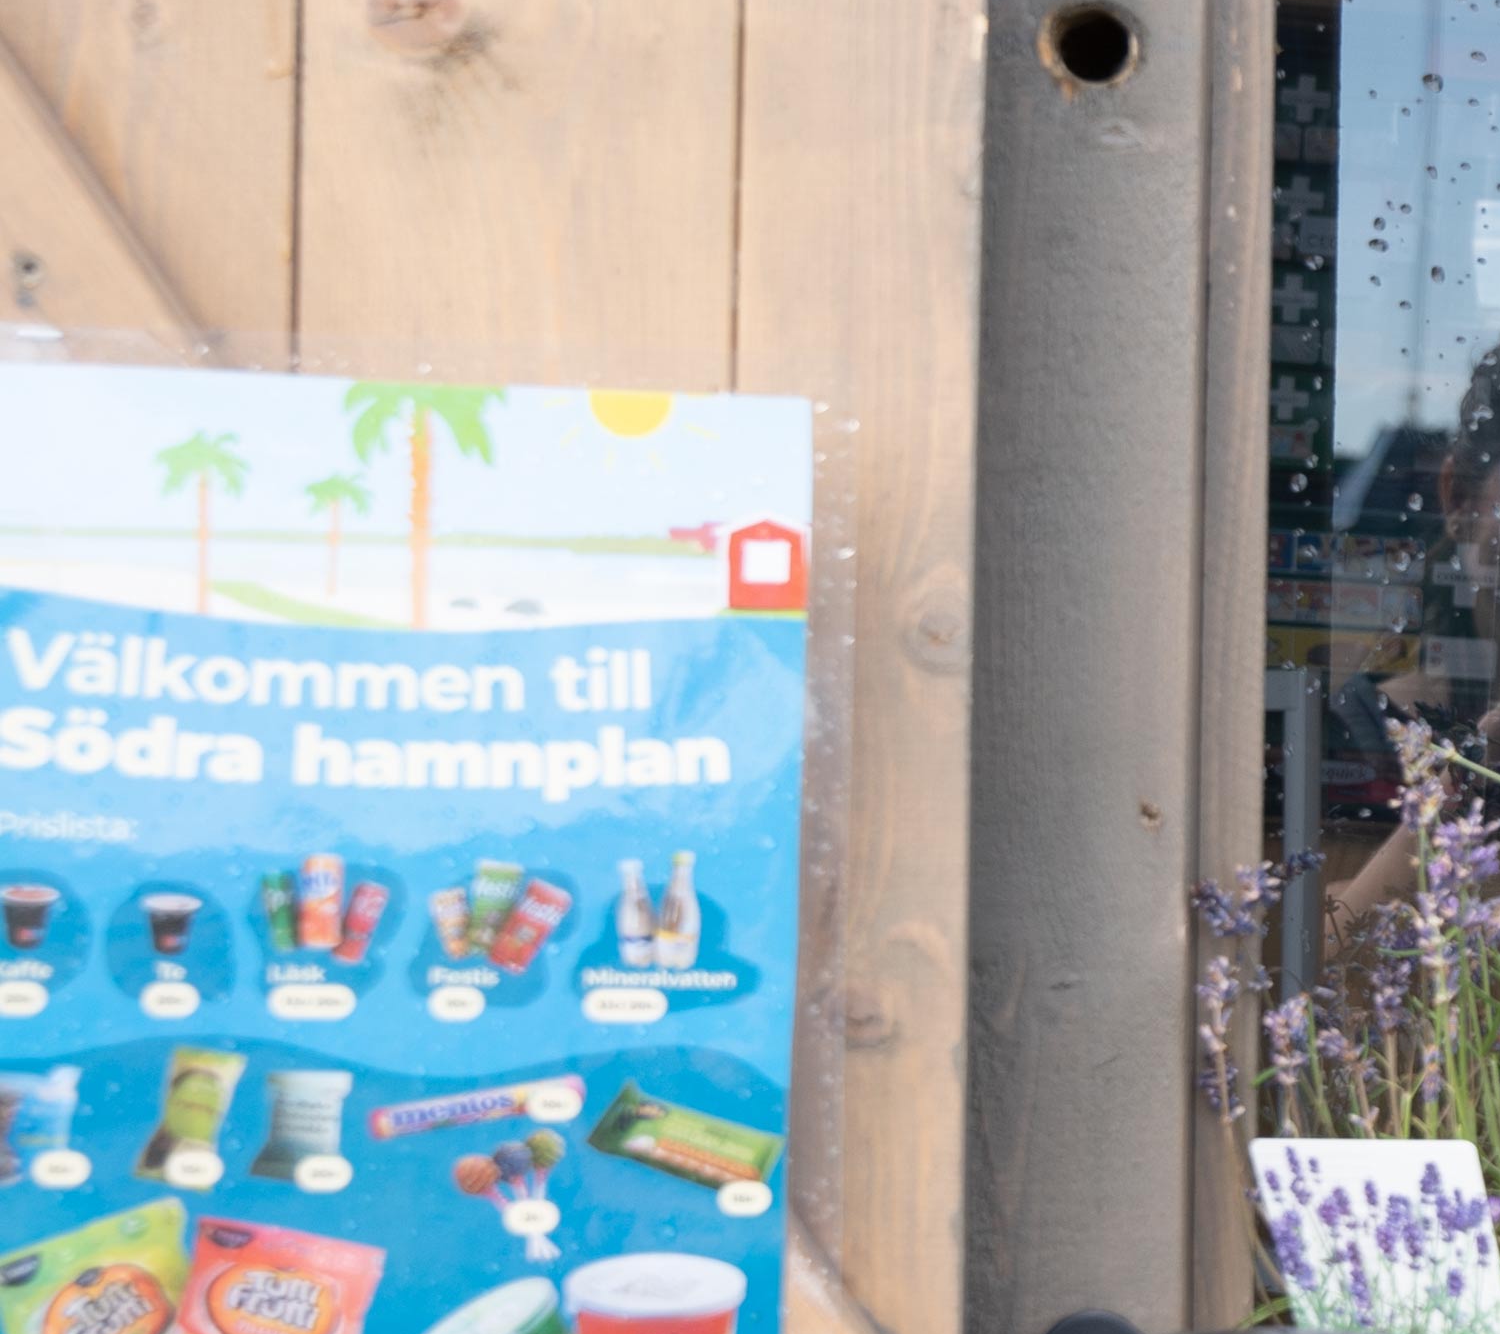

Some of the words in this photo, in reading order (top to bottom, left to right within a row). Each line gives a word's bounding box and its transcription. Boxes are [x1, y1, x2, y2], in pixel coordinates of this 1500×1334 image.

[6, 625, 525, 713] Välkommen
[550, 646, 652, 713] till
[0, 705, 264, 785] Södra
[292, 722, 733, 803] hamnplan
[0, 959, 54, 981] affe
[581, 969, 737, 991] Mineralvatten
